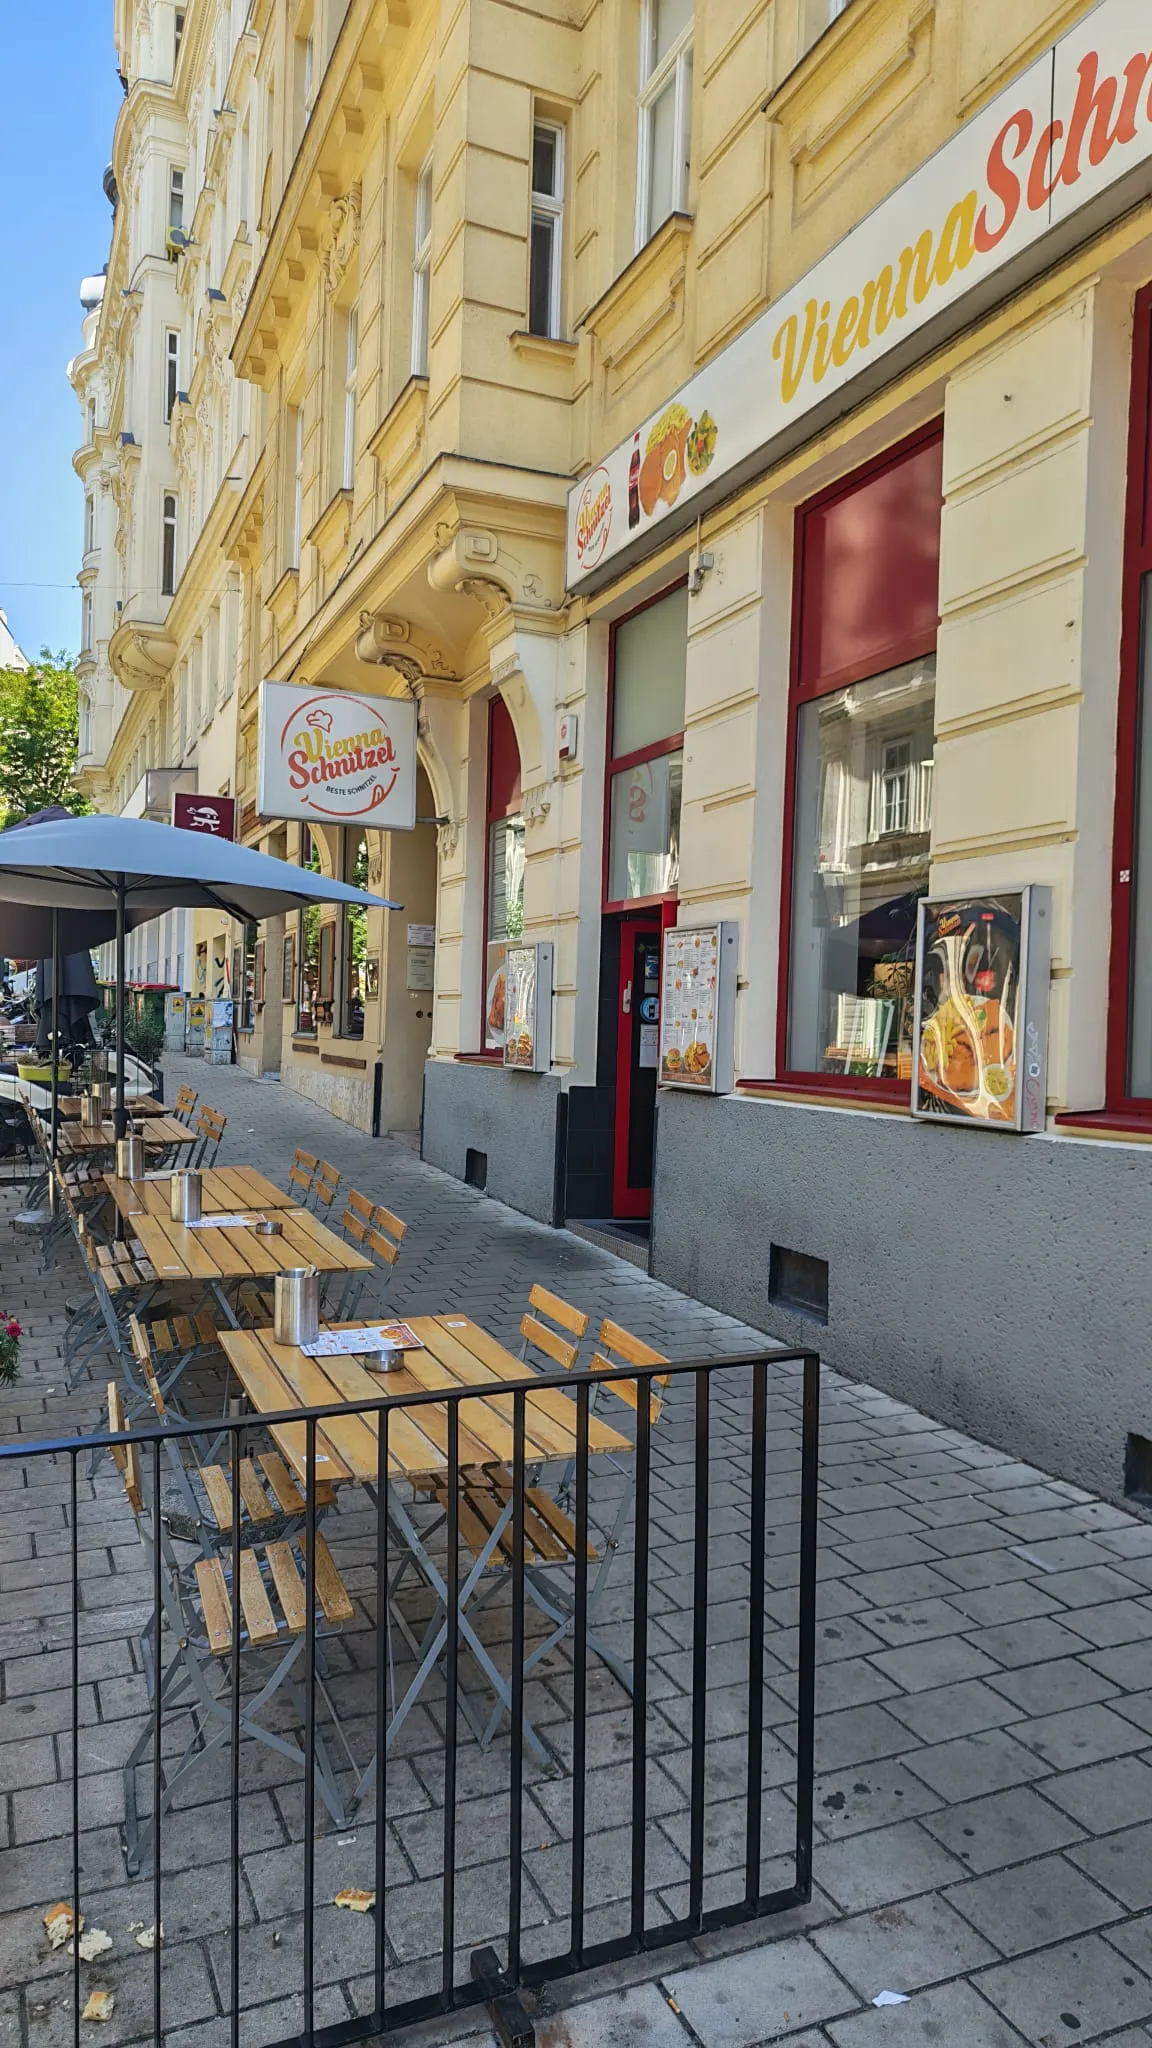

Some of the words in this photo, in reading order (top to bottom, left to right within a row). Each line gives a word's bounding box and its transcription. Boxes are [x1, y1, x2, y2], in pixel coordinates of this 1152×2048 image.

[288, 736, 396, 789] Schnitzel
[293, 728, 384, 763] Vienna
[325, 786, 346, 796] BESTE
[347, 774, 377, 796] SCHNITZEL
